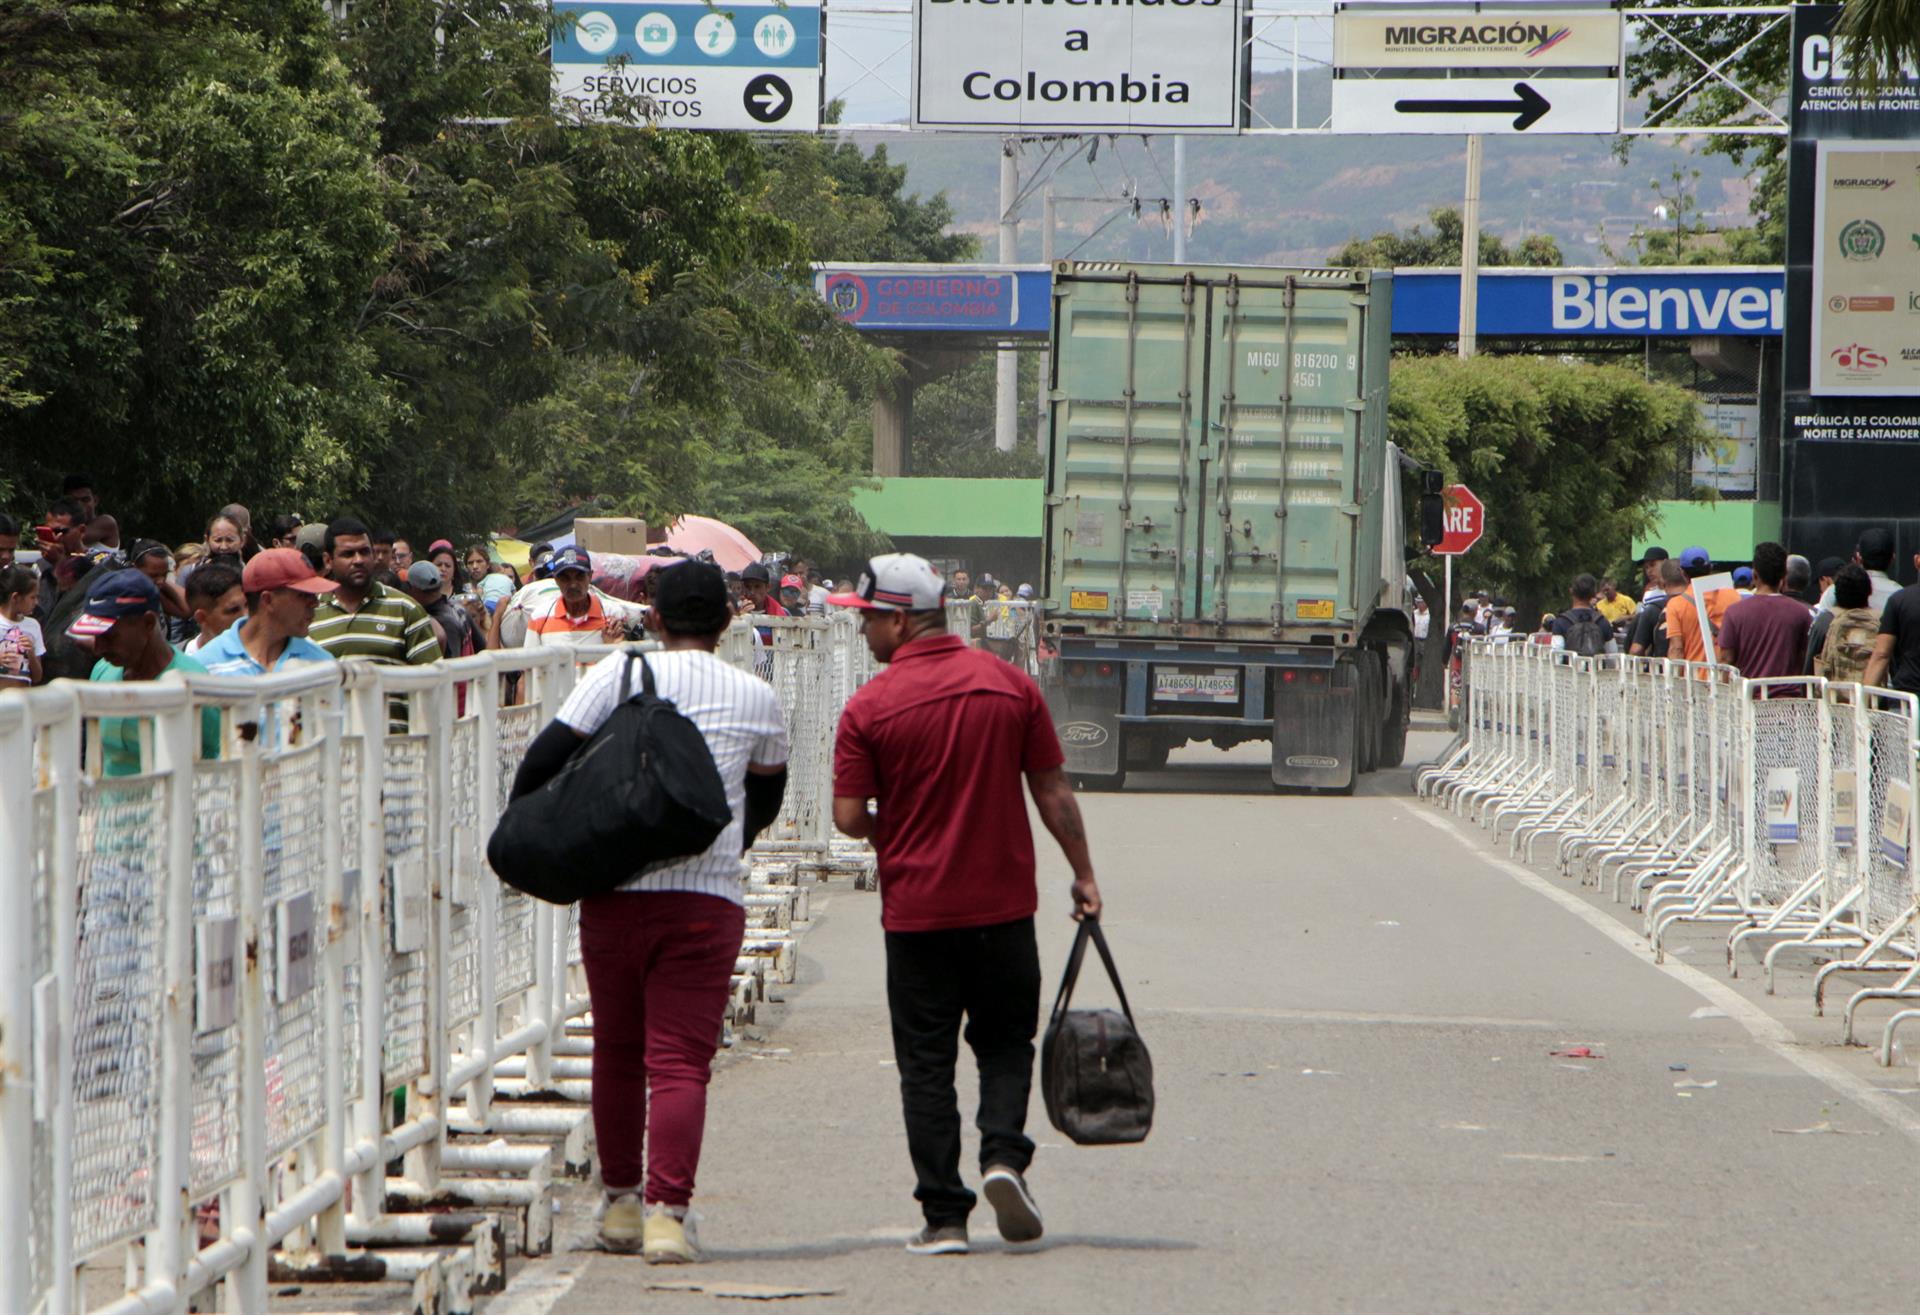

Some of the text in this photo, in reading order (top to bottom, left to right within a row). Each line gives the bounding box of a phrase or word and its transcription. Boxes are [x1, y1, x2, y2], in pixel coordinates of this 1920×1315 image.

[1064, 29, 1089, 51] a
[1385, 21, 1548, 45] MIGRACIÓN
[583, 75, 697, 95] SERVICIOS
[962, 71, 1190, 103] Colombia
[1800, 98, 1858, 110] ATENCIÓN
[1861, 100, 1875, 110] EN
[1833, 178, 1889, 187] MIGRACIÓN
[877, 279, 1001, 297] GOBIERNO
[1247, 352, 1356, 371] MIGU 816200 9
[1293, 372, 1322, 387] 45G1
[1794, 413, 1850, 426] REPÚBLICA
[1853, 416, 1867, 426] DE
[1803, 429, 1920, 439] NORTE DE SANTANDER
[1063, 726, 1101, 741] Ford
